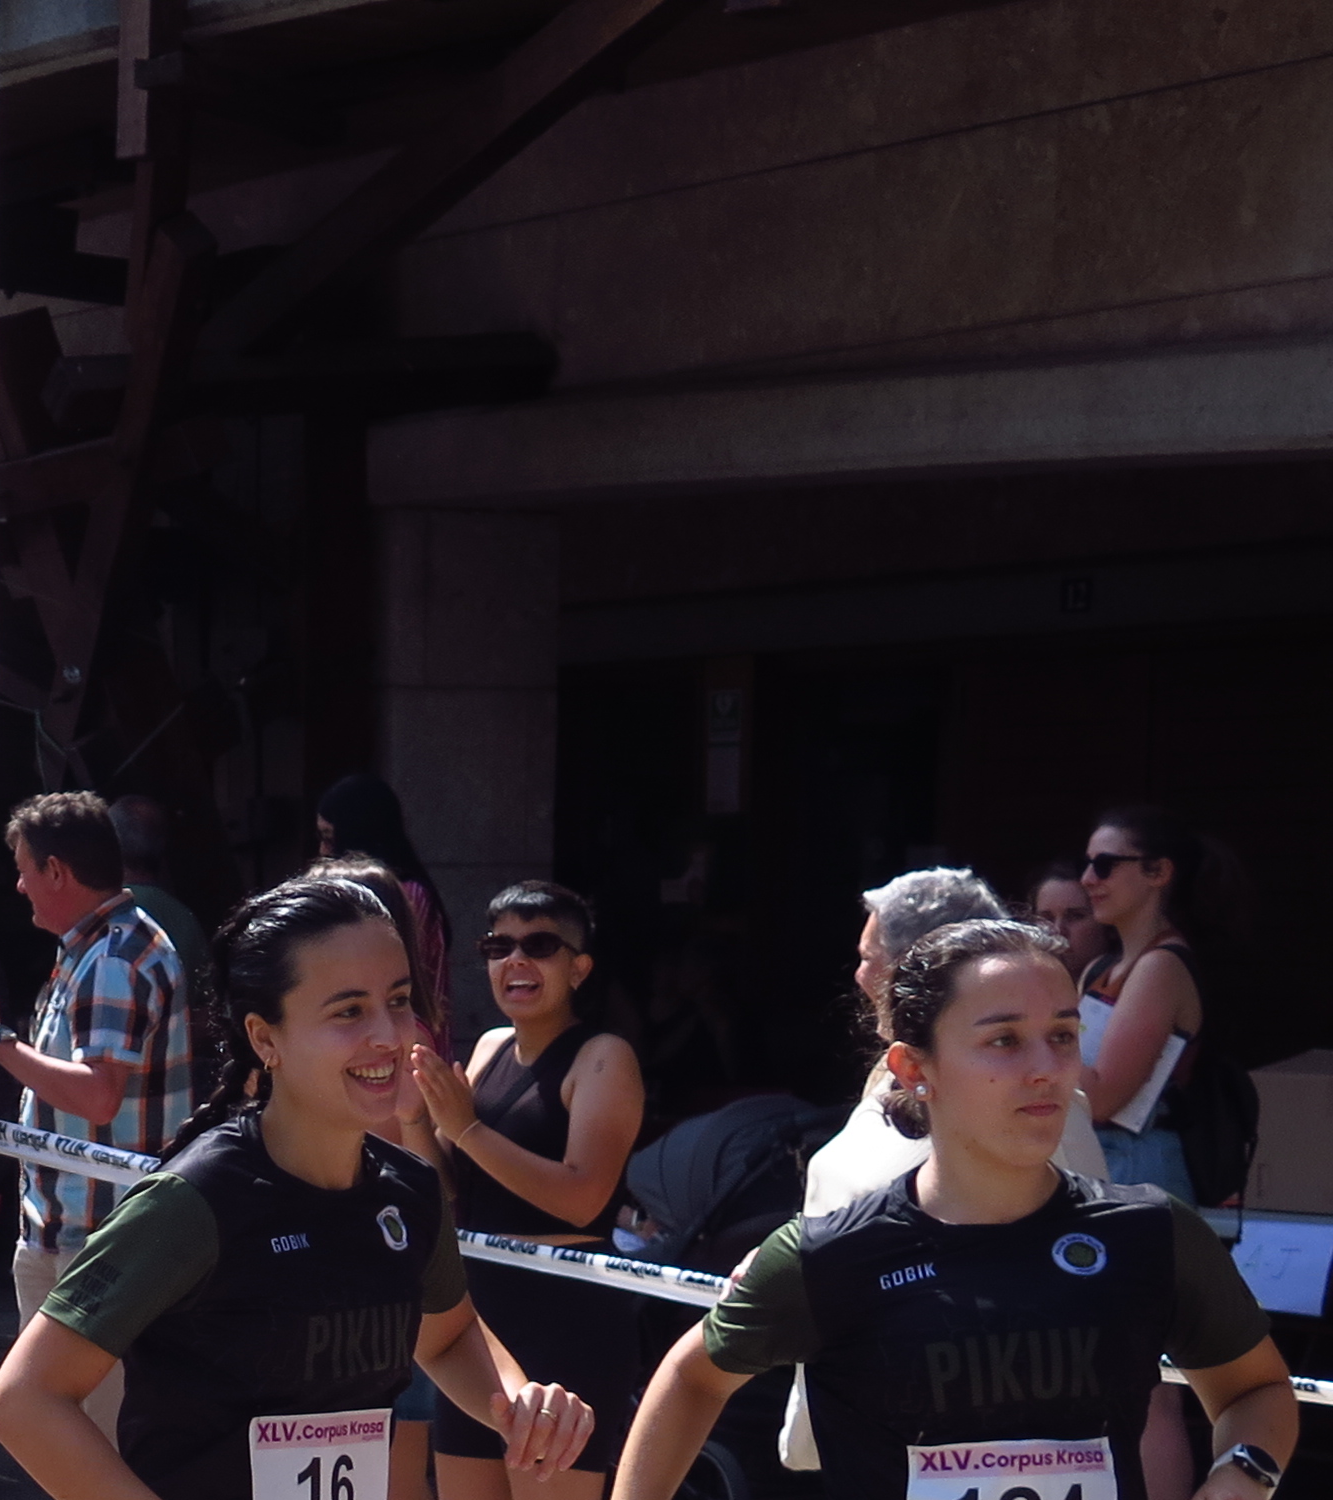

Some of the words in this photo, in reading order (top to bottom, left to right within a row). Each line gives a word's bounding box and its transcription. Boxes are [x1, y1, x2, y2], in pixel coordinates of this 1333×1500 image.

[271, 1233, 310, 1253] GOBIK
[879, 1262, 937, 1290] GOBIK
[304, 1301, 411, 1381] PIKUK
[924, 1325, 1101, 1412] PIKUK
[350, 1420, 384, 1435] Krosa
[1056, 1449, 1104, 1465] Krosa
